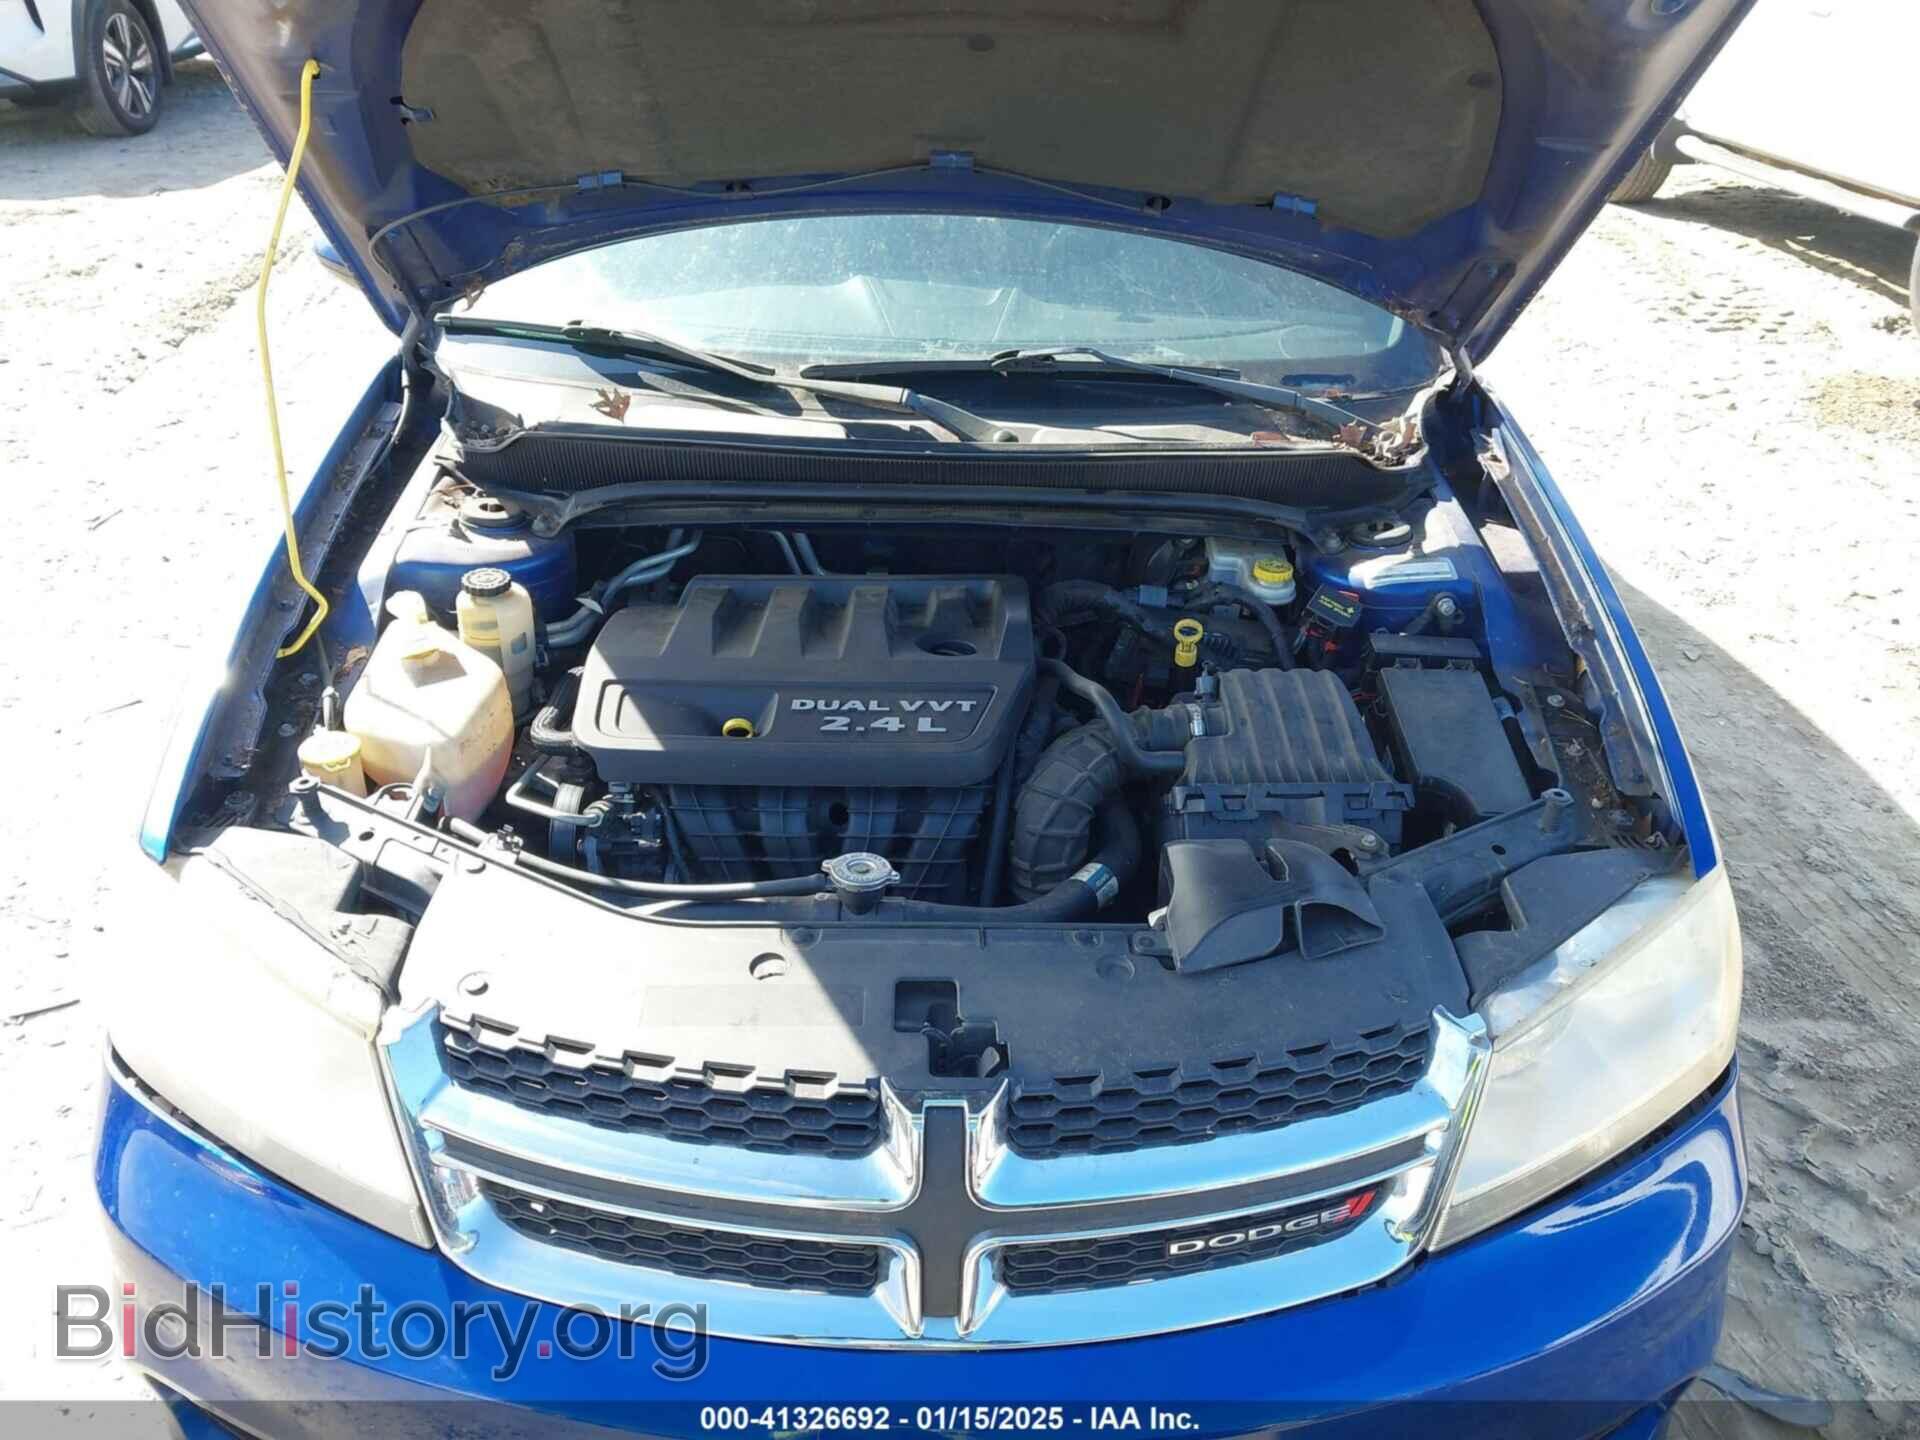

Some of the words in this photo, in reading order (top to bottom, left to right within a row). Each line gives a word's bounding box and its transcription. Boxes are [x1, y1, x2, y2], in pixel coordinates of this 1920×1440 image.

[791, 699, 890, 711] DUAL
[900, 700, 976, 712] VVT
[1169, 1204, 1351, 1255] DODGE
